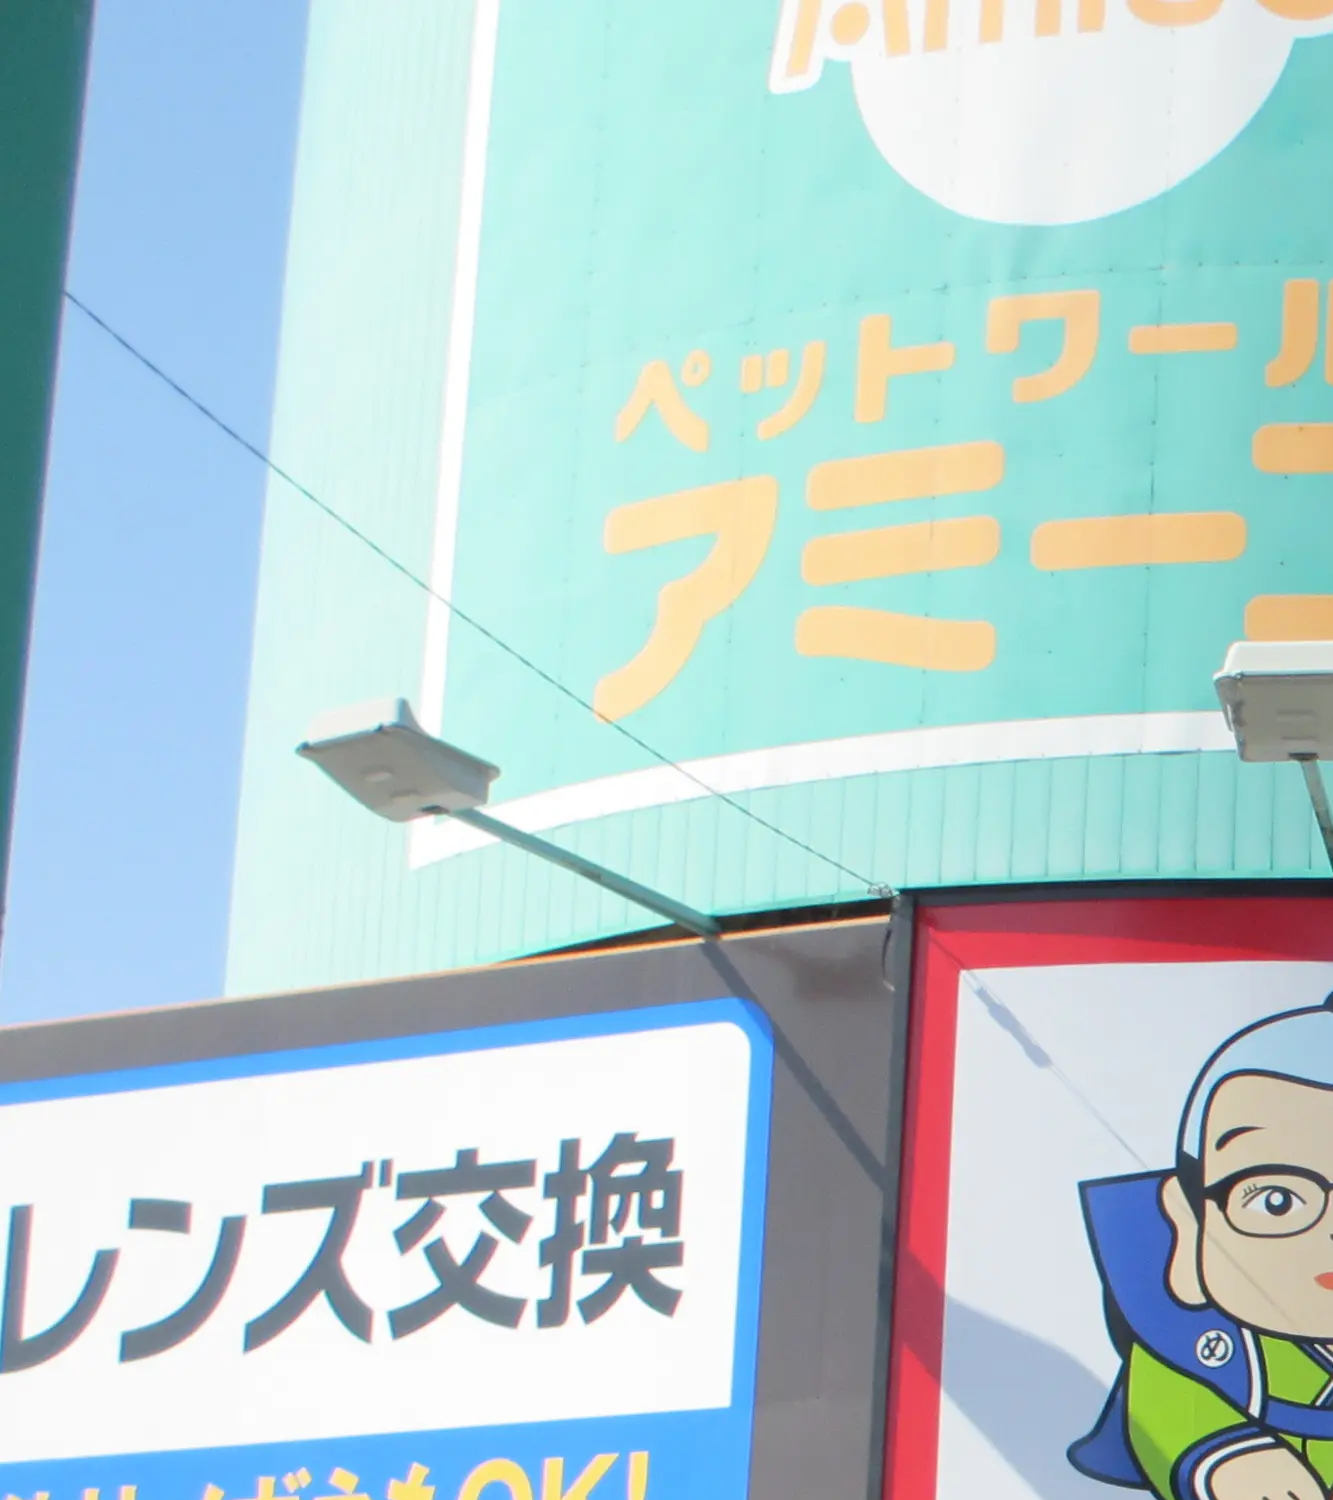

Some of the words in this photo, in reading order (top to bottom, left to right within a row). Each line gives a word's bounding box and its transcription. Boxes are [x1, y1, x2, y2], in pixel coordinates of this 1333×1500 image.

[0, 1131, 686, 1375] レンズ交換
